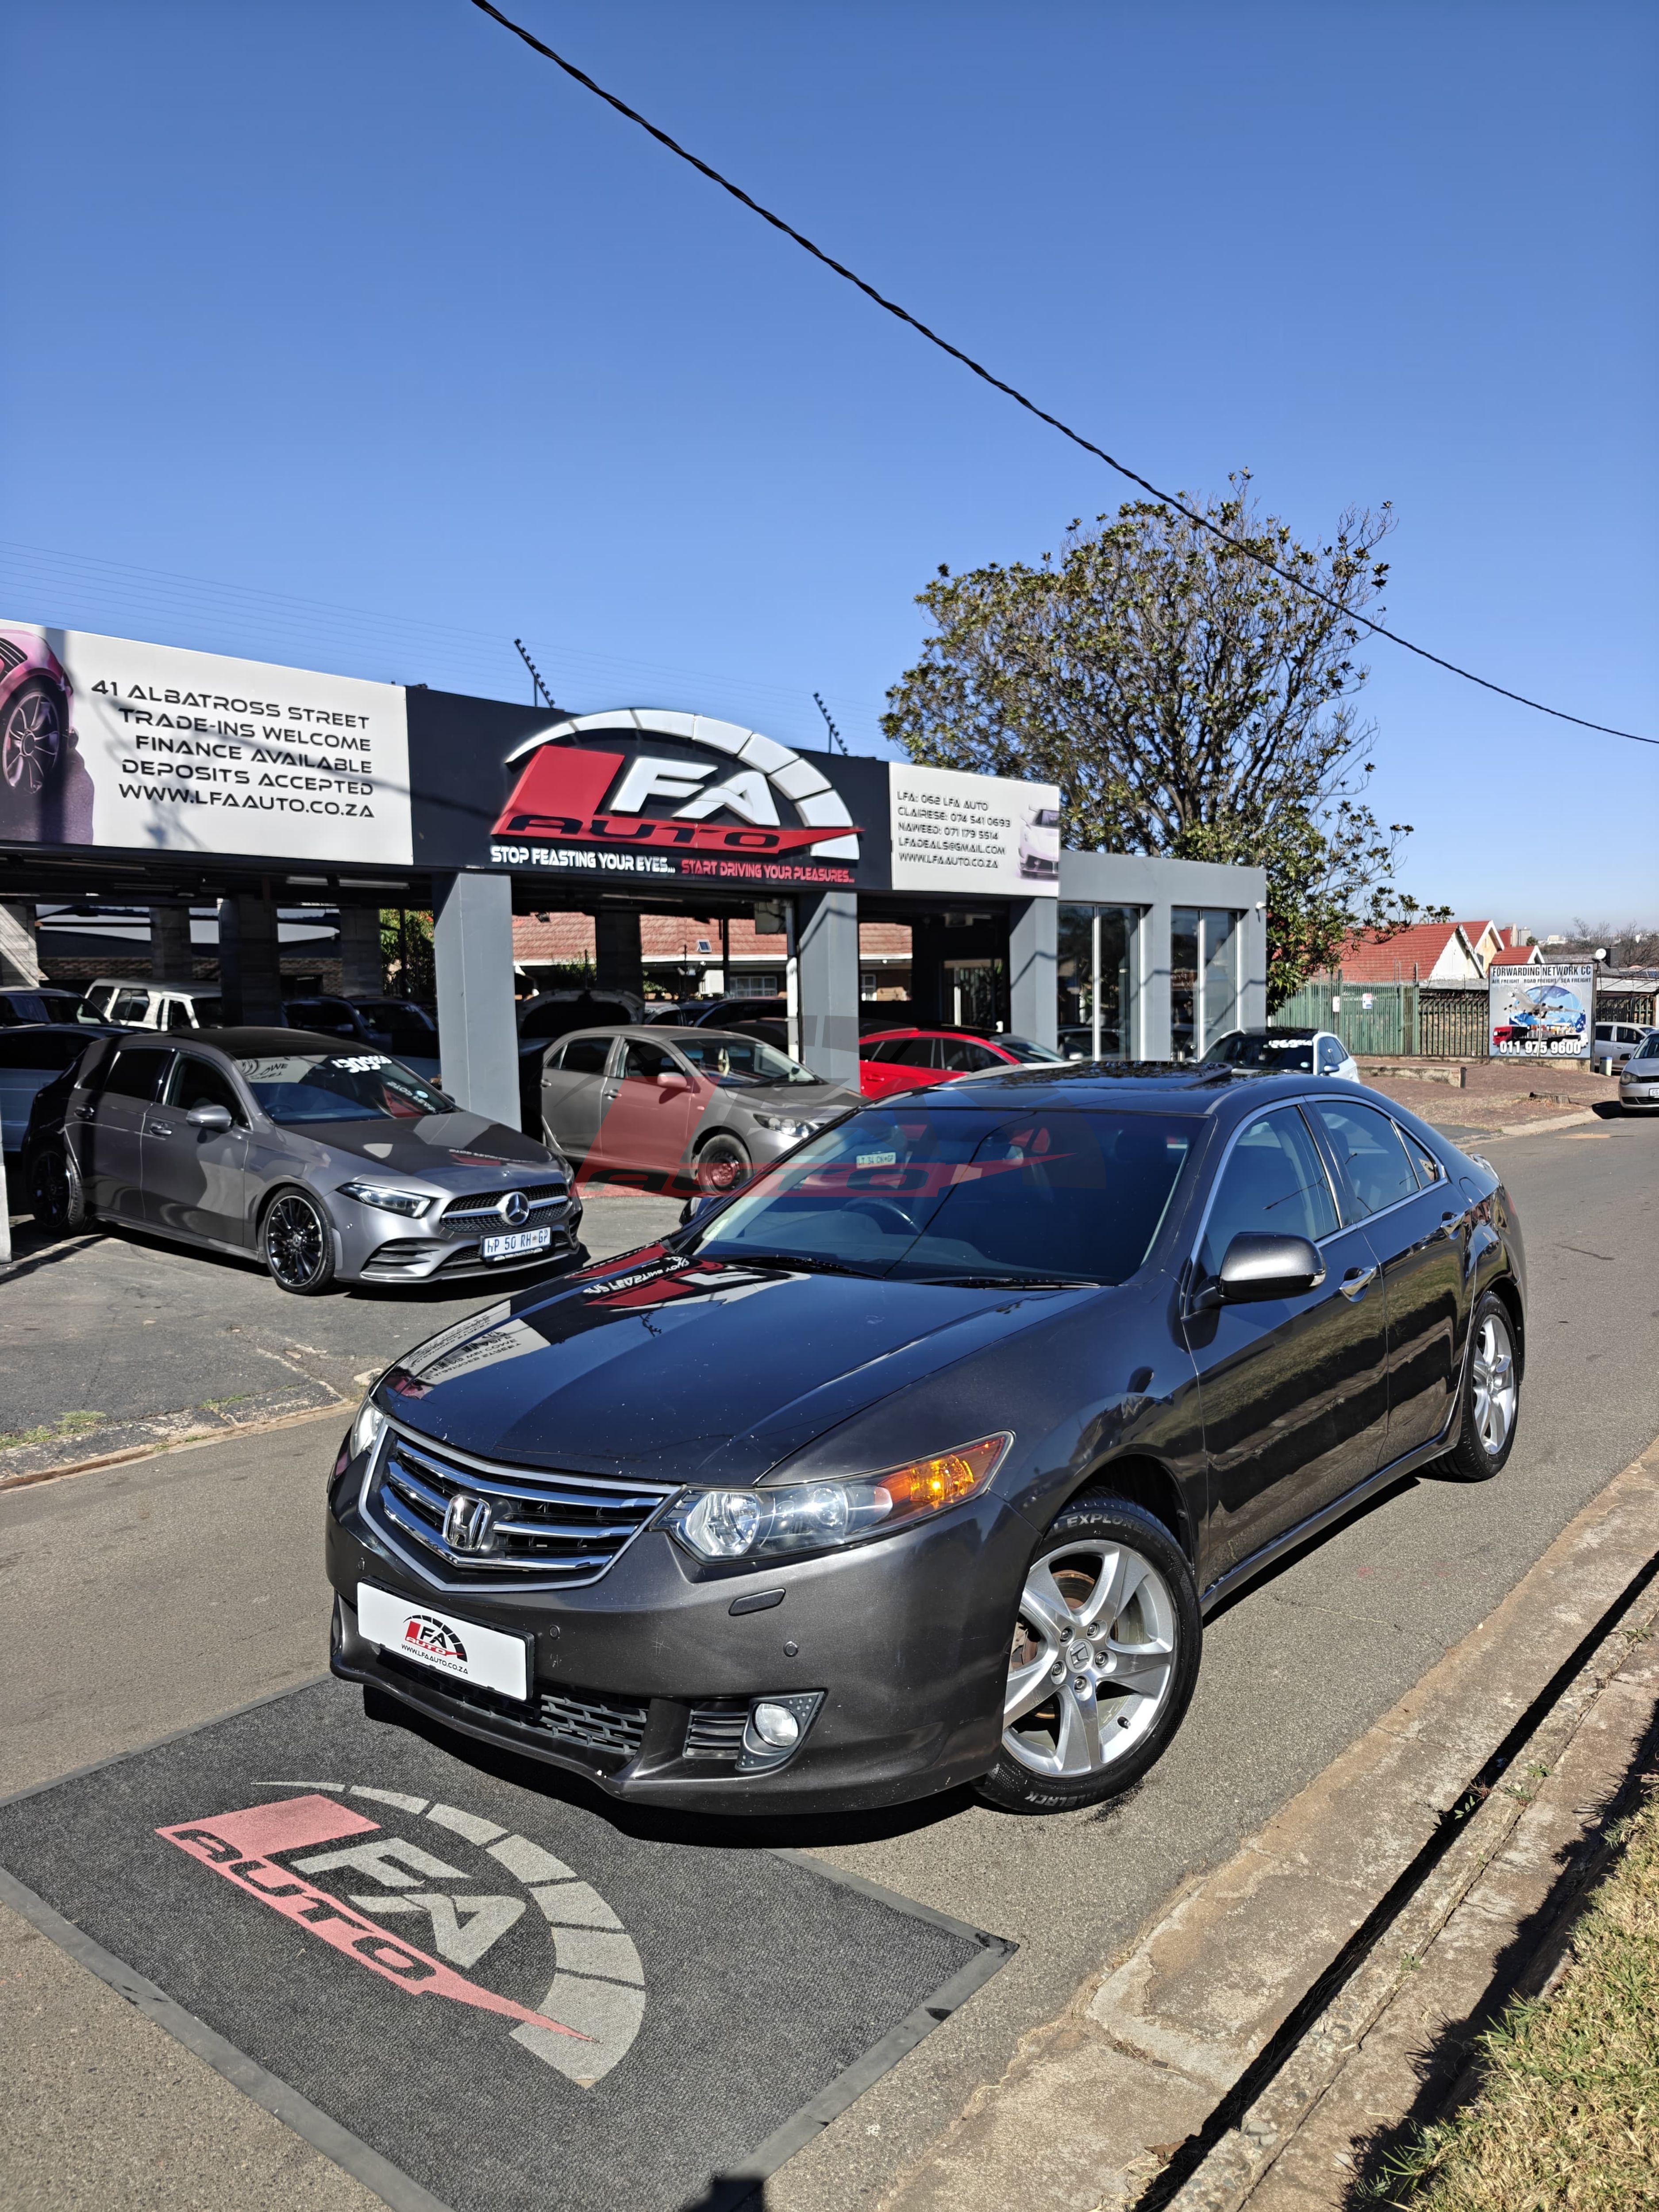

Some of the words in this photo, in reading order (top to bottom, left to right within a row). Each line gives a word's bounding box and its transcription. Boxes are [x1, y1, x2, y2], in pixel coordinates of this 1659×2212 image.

[91, 680, 118, 696] 41
[127, 685, 281, 718] ALBATROSS
[288, 706, 370, 729] STREET
[118, 708, 255, 738] TRADE-INS
[262, 726, 371, 751] WELCOME
[136, 735, 242, 760] FINANCE
[250, 748, 373, 774] AVAILABLE
[122, 759, 250, 784] DEPOSITS
[258, 773, 373, 795] ACCEPTED
[119, 783, 375, 818] WWW.LFAAUTO.CO.ZA
[897, 791, 919, 802] LFA:
[921, 794, 941, 805] 062
[943, 797, 960, 808] LFA
[963, 800, 989, 811] AUTO
[506, 814, 780, 849] AUTO
[944, 827, 959, 837] 071
[951, 813, 967, 823] 074
[970, 816, 985, 825] 541
[987, 817, 1011, 827] 0693
[490, 845, 530, 864] STOP
[531, 847, 596, 868] FEASTING
[597, 852, 635, 871] YOUR
[635, 855, 676, 873] EYES...
[681, 859, 717, 875] START
[719, 861, 762, 878] DRIVING
[763, 864, 792, 880] YOUR
[794, 866, 855, 883] PLEASURES...
[1493, 967, 1540, 977] FORWARDING
[1542, 966, 1578, 976] NETWORK
[1581, 966, 1591, 975] CC
[1499, 1040, 1520, 1054] 011
[1525, 1041, 1547, 1054] 975
[1550, 1041, 1582, 1054] 9600
[504, 1236, 516, 1250] 50
[520, 1233, 531, 1247] RH
[539, 1229, 548, 1243] GP
[401, 1643, 468, 1674] WWW.LFAAUTO.CO.ZA
[406, 1636, 446, 1655] AUTO
[173, 1830, 437, 1980] AUTO
